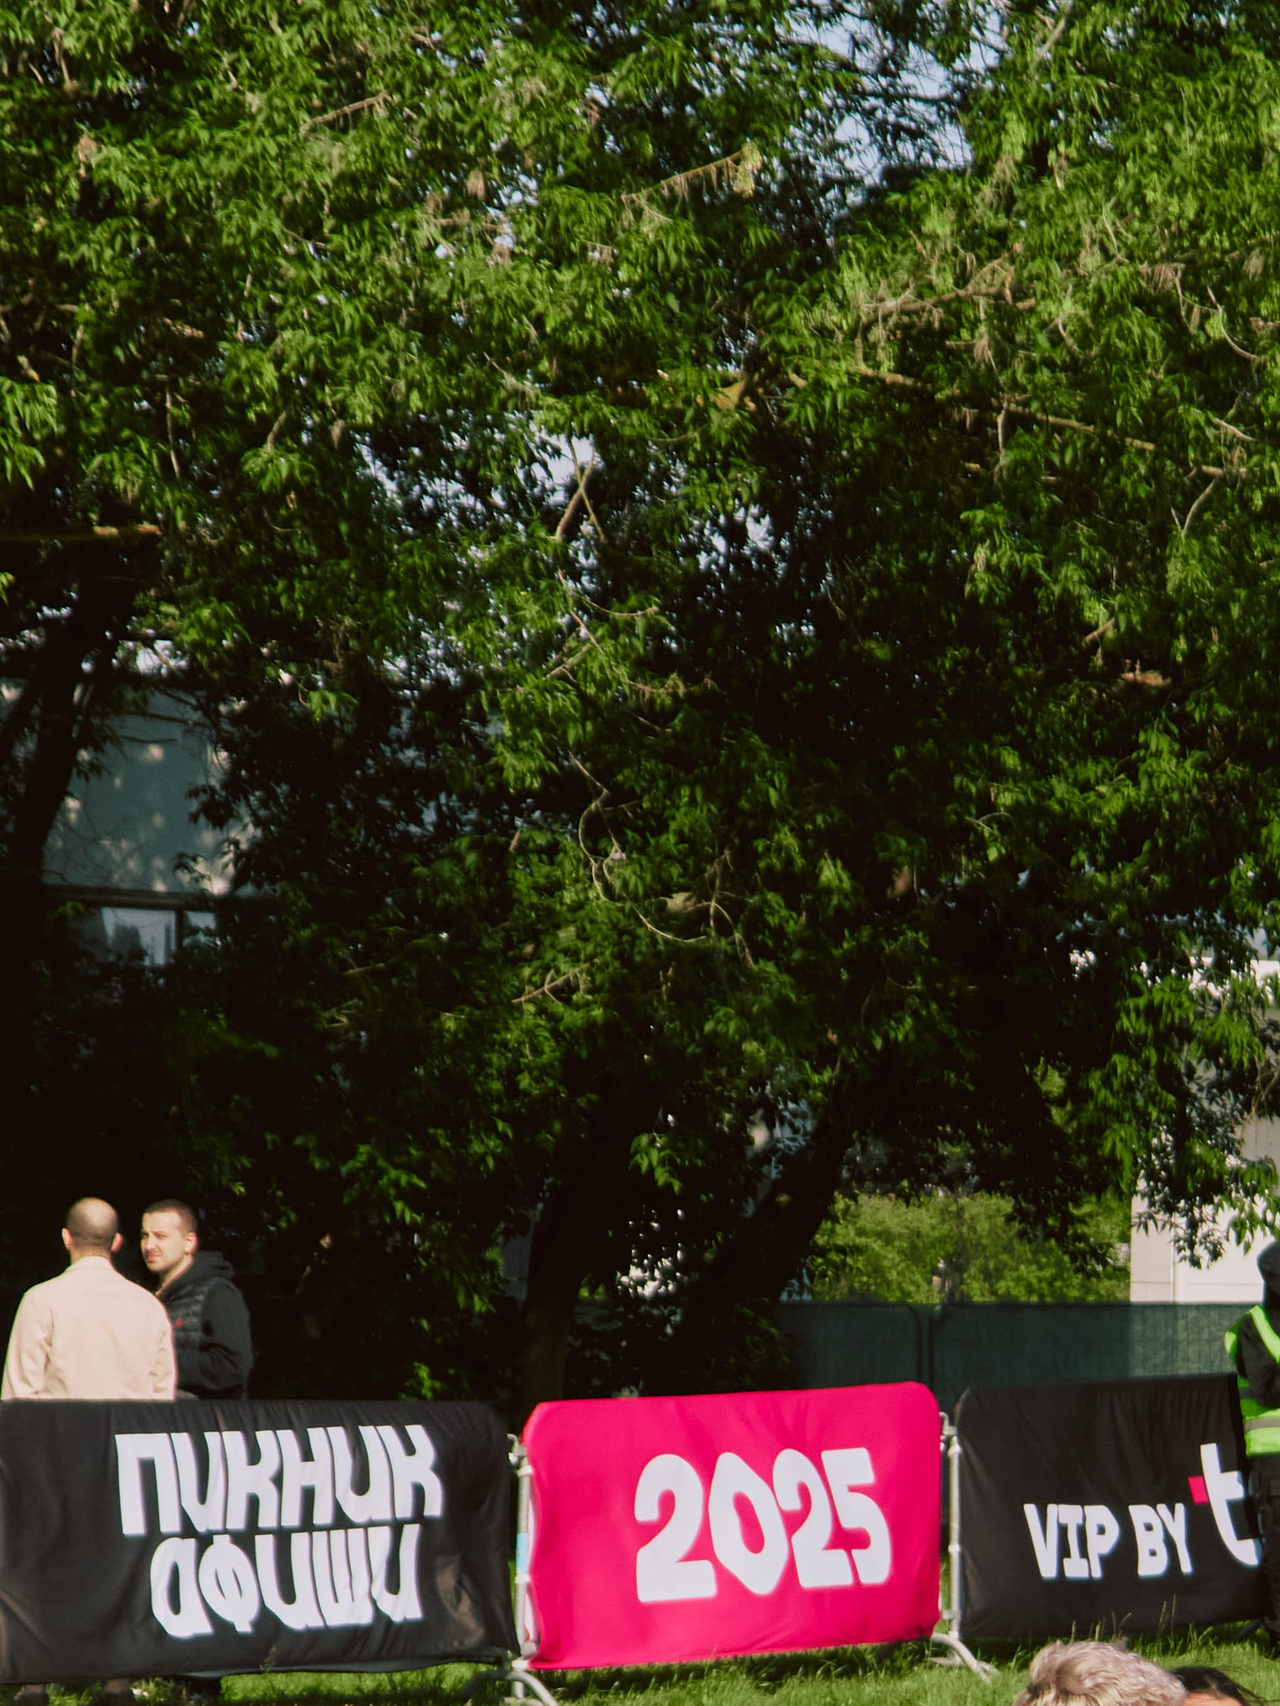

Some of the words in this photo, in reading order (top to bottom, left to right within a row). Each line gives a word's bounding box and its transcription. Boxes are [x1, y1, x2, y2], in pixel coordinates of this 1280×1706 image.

[633, 1447, 892, 1602] 2025
[1023, 1503, 1120, 1579] VIP
[1129, 1502, 1193, 1577] BY
